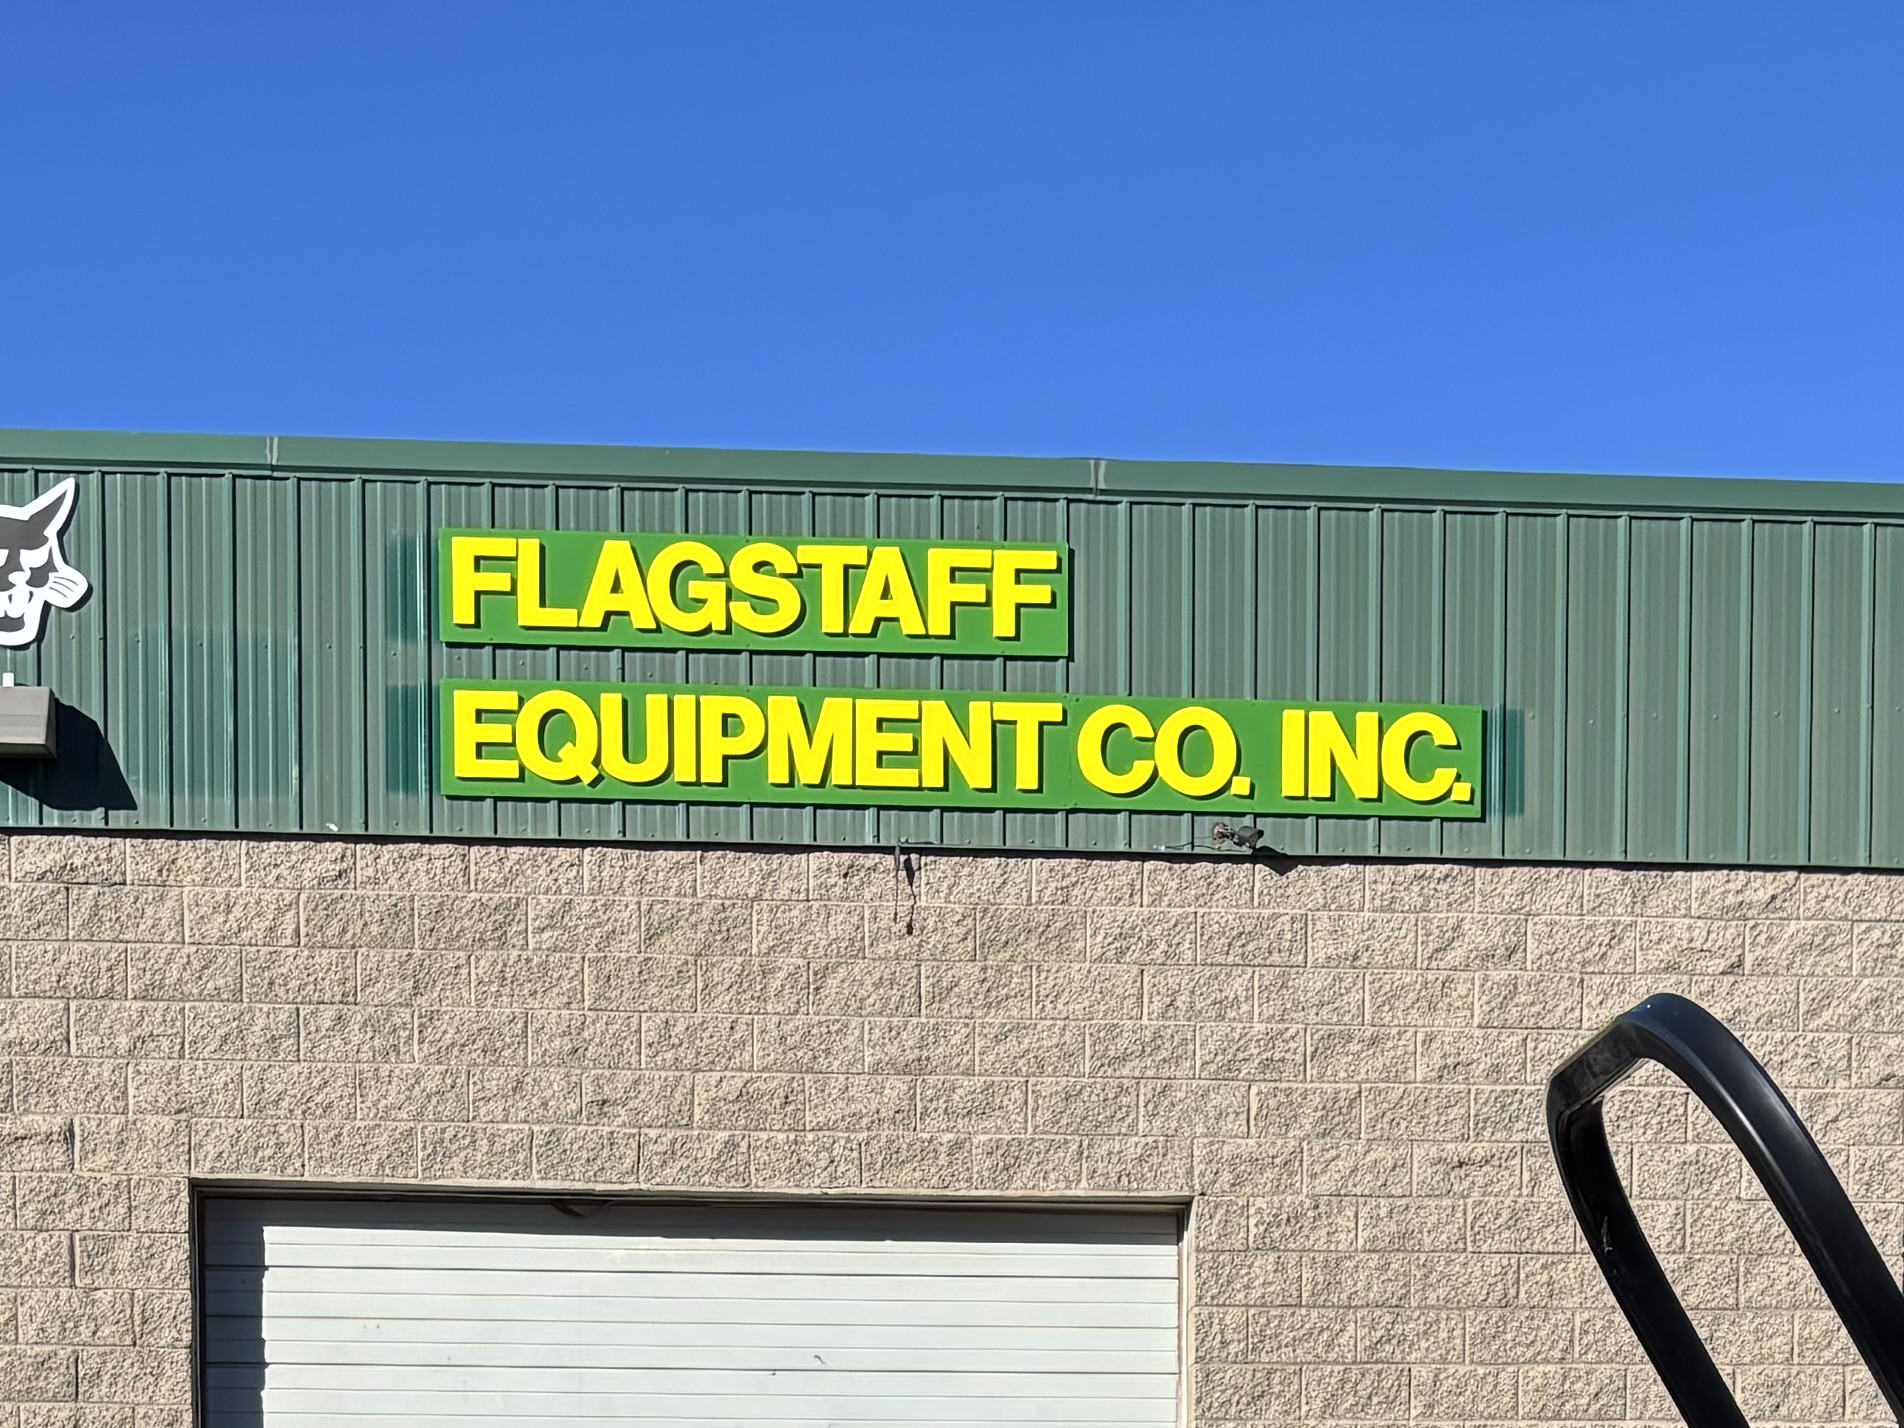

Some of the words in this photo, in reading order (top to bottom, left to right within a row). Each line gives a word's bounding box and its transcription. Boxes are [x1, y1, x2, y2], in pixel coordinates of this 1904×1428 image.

[451, 536, 1059, 637] FLAGSTAFF
[452, 689, 1064, 790] EQUIPMENT
[1077, 704, 1252, 797] CO.
[1281, 709, 1473, 802] INC.
